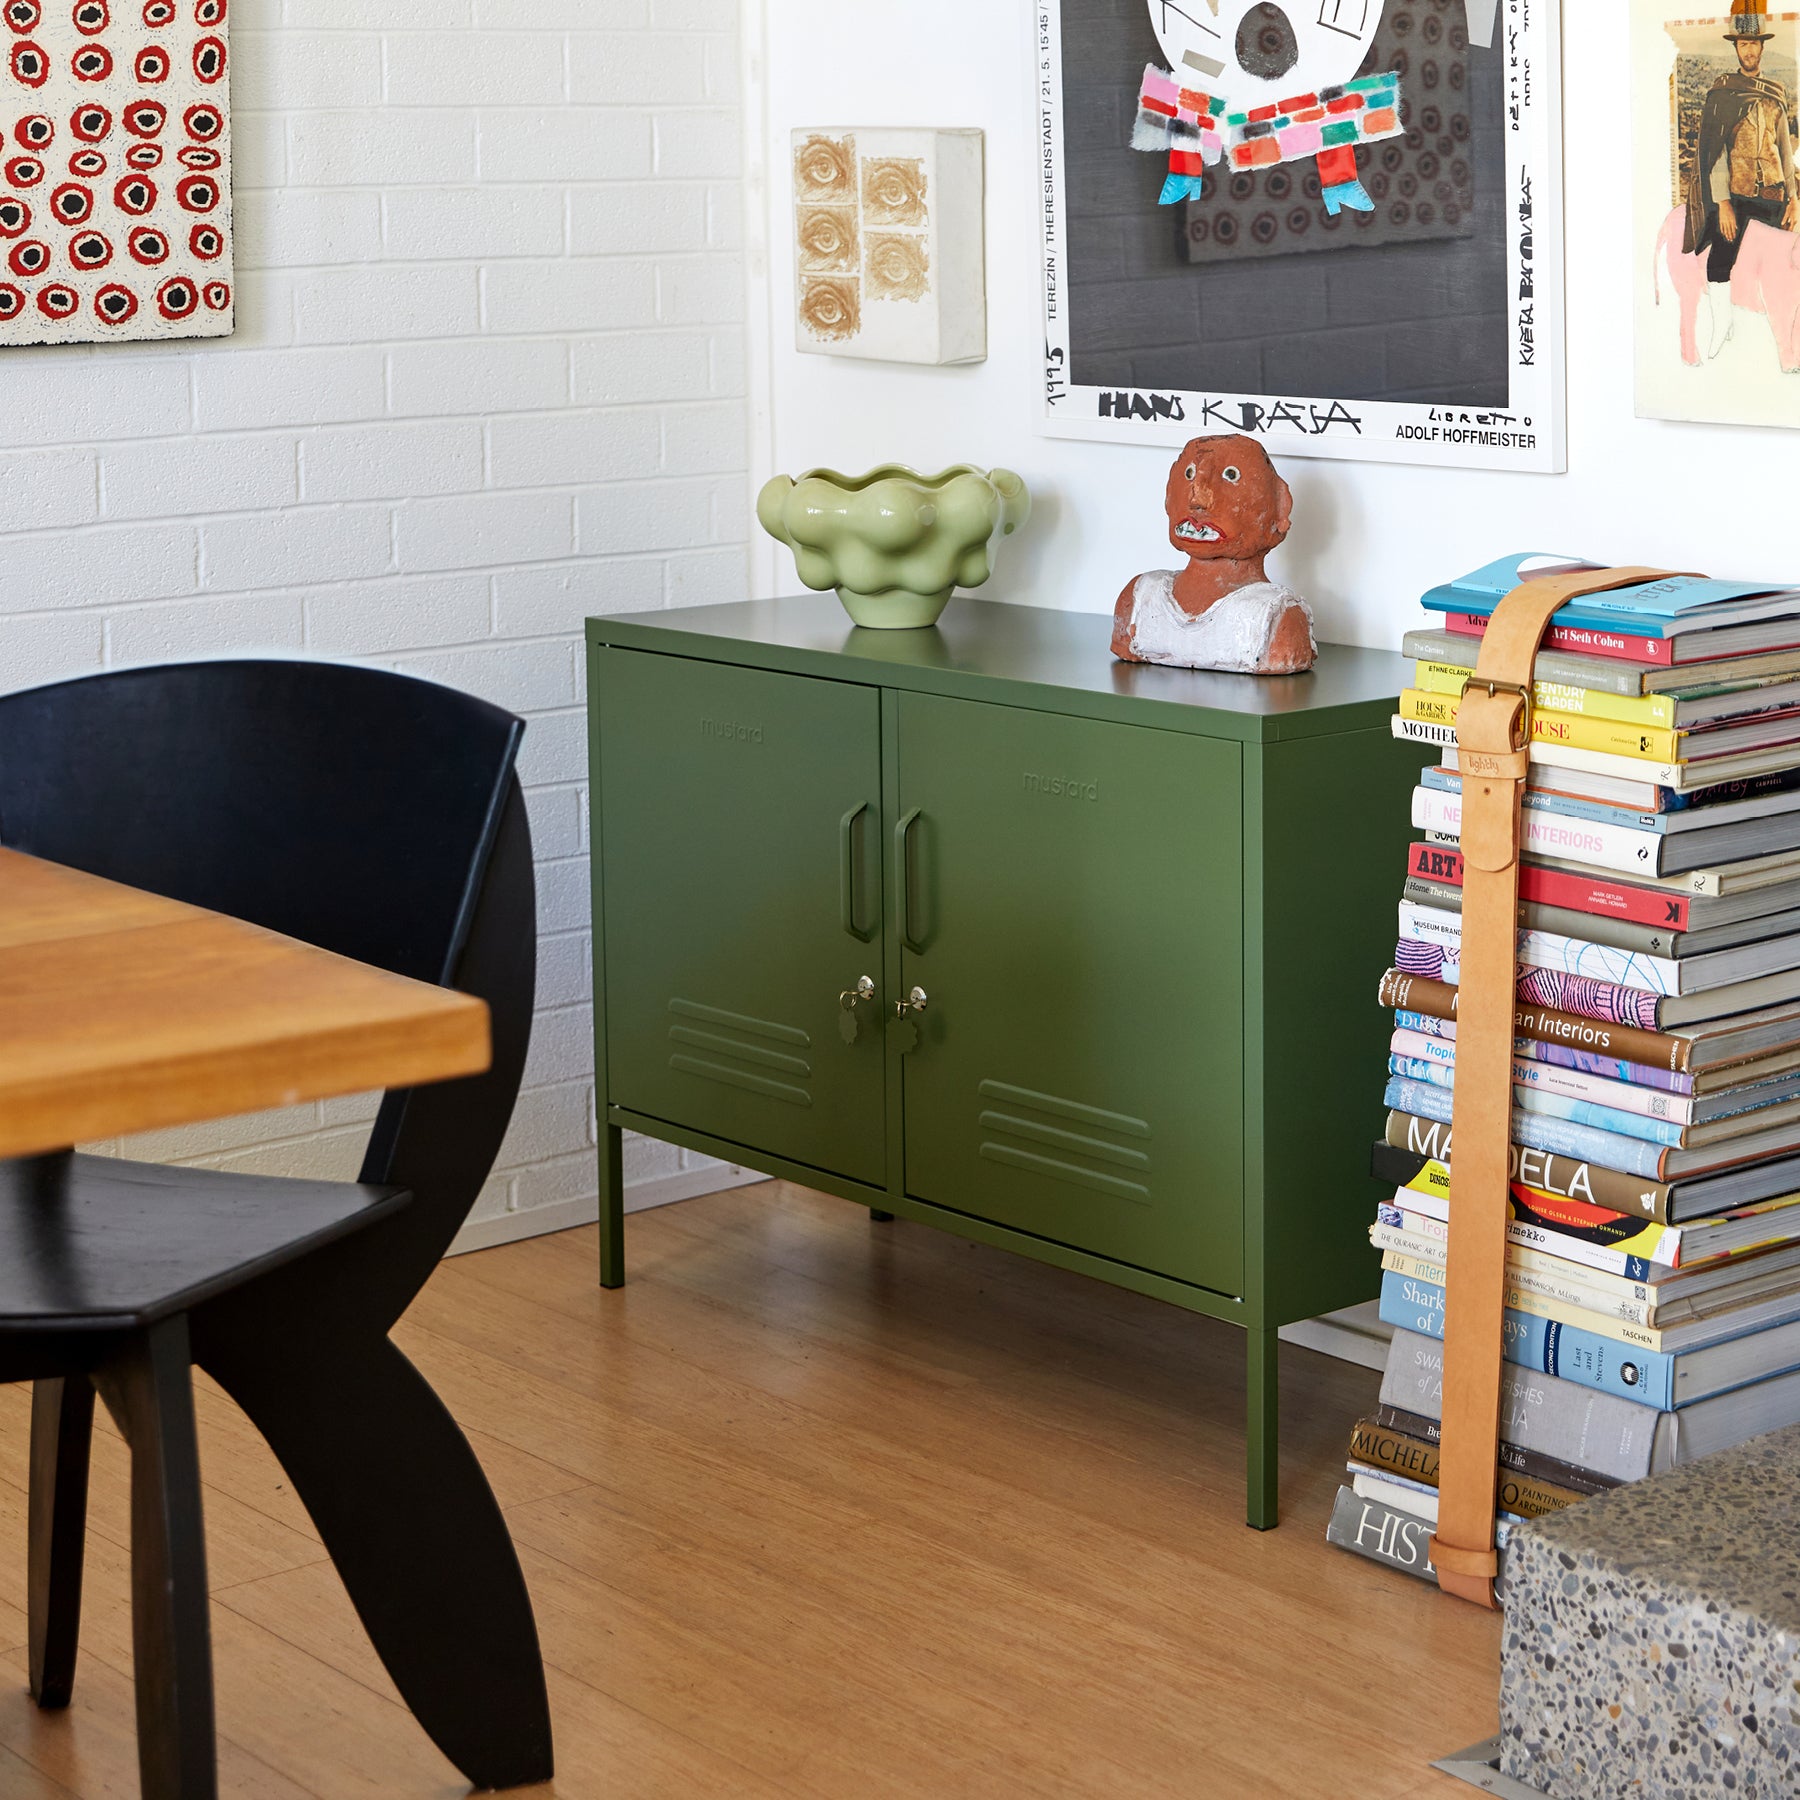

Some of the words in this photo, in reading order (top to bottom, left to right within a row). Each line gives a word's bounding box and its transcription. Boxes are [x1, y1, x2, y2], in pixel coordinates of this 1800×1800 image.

[1042, 109, 1056, 245] THERESIENSTADT
[1046, 336, 1066, 406] 1995
[1098, 391, 1185, 422] HANS
[1396, 424, 1439, 441] ADOLF
[1443, 427, 1536, 449] HOFFMEISTER
[1552, 627, 1568, 640] Ari
[1570, 630, 1591, 644] Seth
[1593, 633, 1625, 649] Cohen
[1414, 643, 1424, 652] The
[1425, 645, 1444, 656] Camera
[1428, 666, 1448, 674] ETHNE
[1448, 668, 1473, 677] CLARKE
[1533, 681, 1586, 699] CENTURY
[1416, 700, 1447, 714] HOUSE
[1536, 694, 1583, 713] GARDEN
[701, 716, 764, 744] mustard
[1468, 755, 1499, 774] lightly
[1023, 772, 1099, 801] mustard
[1527, 822, 1604, 852] INTERIORS
[1417, 850, 1457, 878] ART
[1409, 882, 1430, 893] Home
[1430, 886, 1443, 897] The
[1593, 890, 1606, 898] MARK
[1413, 921, 1440, 932] MUSEUM
[1440, 925, 1462, 937] BRAND
[1538, 1013, 1610, 1047] Interiors
[1513, 1064, 1539, 1081] Style
[1429, 1172, 1450, 1187] DINOS
[1528, 1204, 1548, 1215] LOUISE
[1549, 1209, 1567, 1220] OLSEN
[1573, 1216, 1598, 1229] STEPHEN
[1599, 1224, 1627, 1237] ORMANDY
[1381, 1233, 1391, 1243] THE
[1393, 1237, 1422, 1252] QURANIC
[1424, 1247, 1436, 1256] ART
[1417, 1312, 1436, 1332] of
[1622, 1329, 1653, 1344] TASCHEN
[1414, 1350, 1444, 1373] SWA
[1549, 1343, 1557, 1375] SECOND
[1573, 1347, 1582, 1368] Last
[1584, 1351, 1592, 1371] and
[1594, 1346, 1605, 1383] Stevens
[1417, 1375, 1433, 1394] of
[1509, 1452, 1526, 1467] Life
